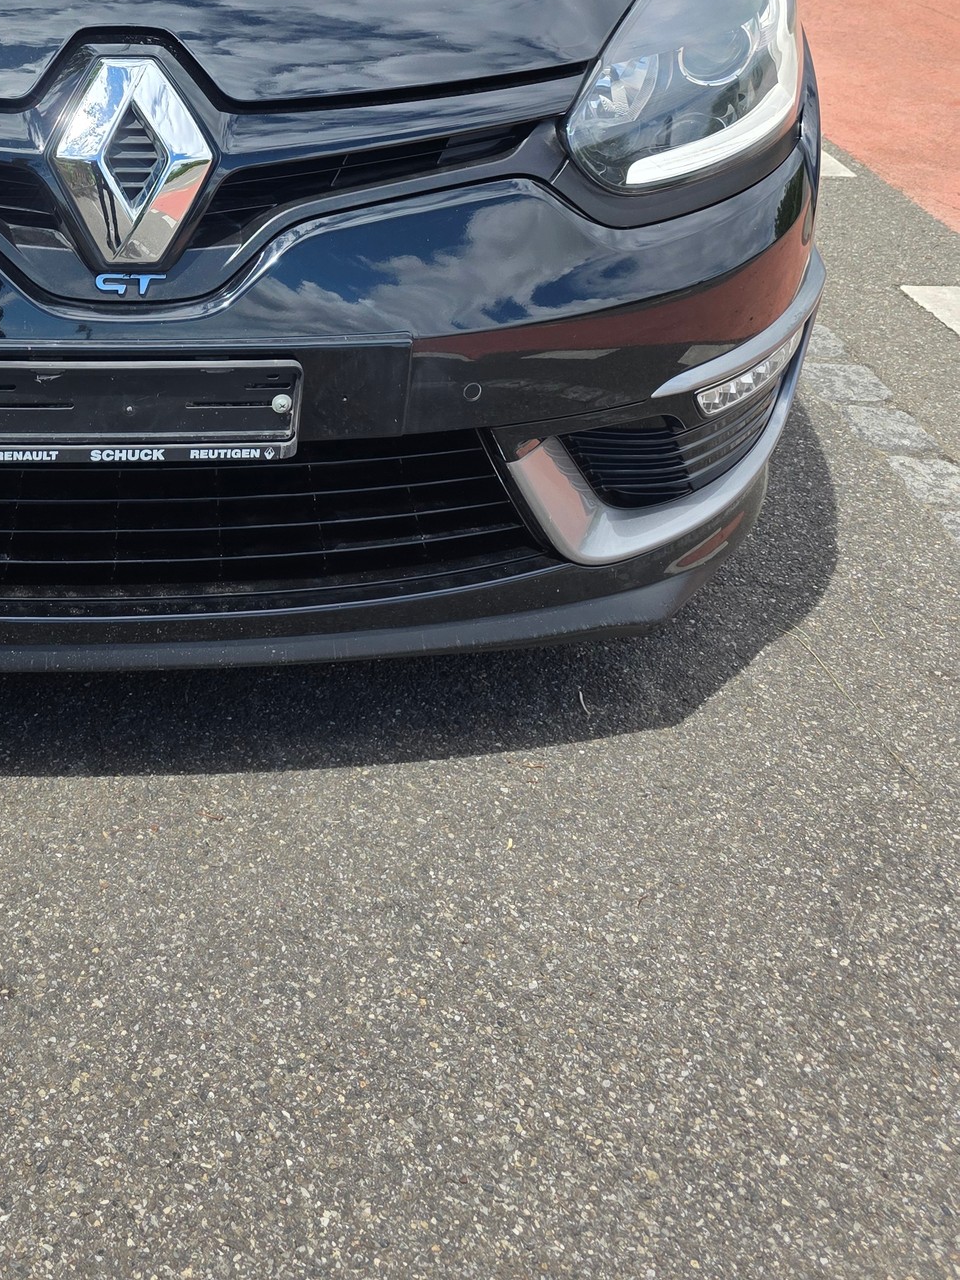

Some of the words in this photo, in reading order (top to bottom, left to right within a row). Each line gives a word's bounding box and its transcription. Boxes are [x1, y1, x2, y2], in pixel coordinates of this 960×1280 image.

[95, 273, 167, 295] GT
[90, 448, 165, 462] SCHUCK
[189, 448, 261, 460] REUTIGEN
